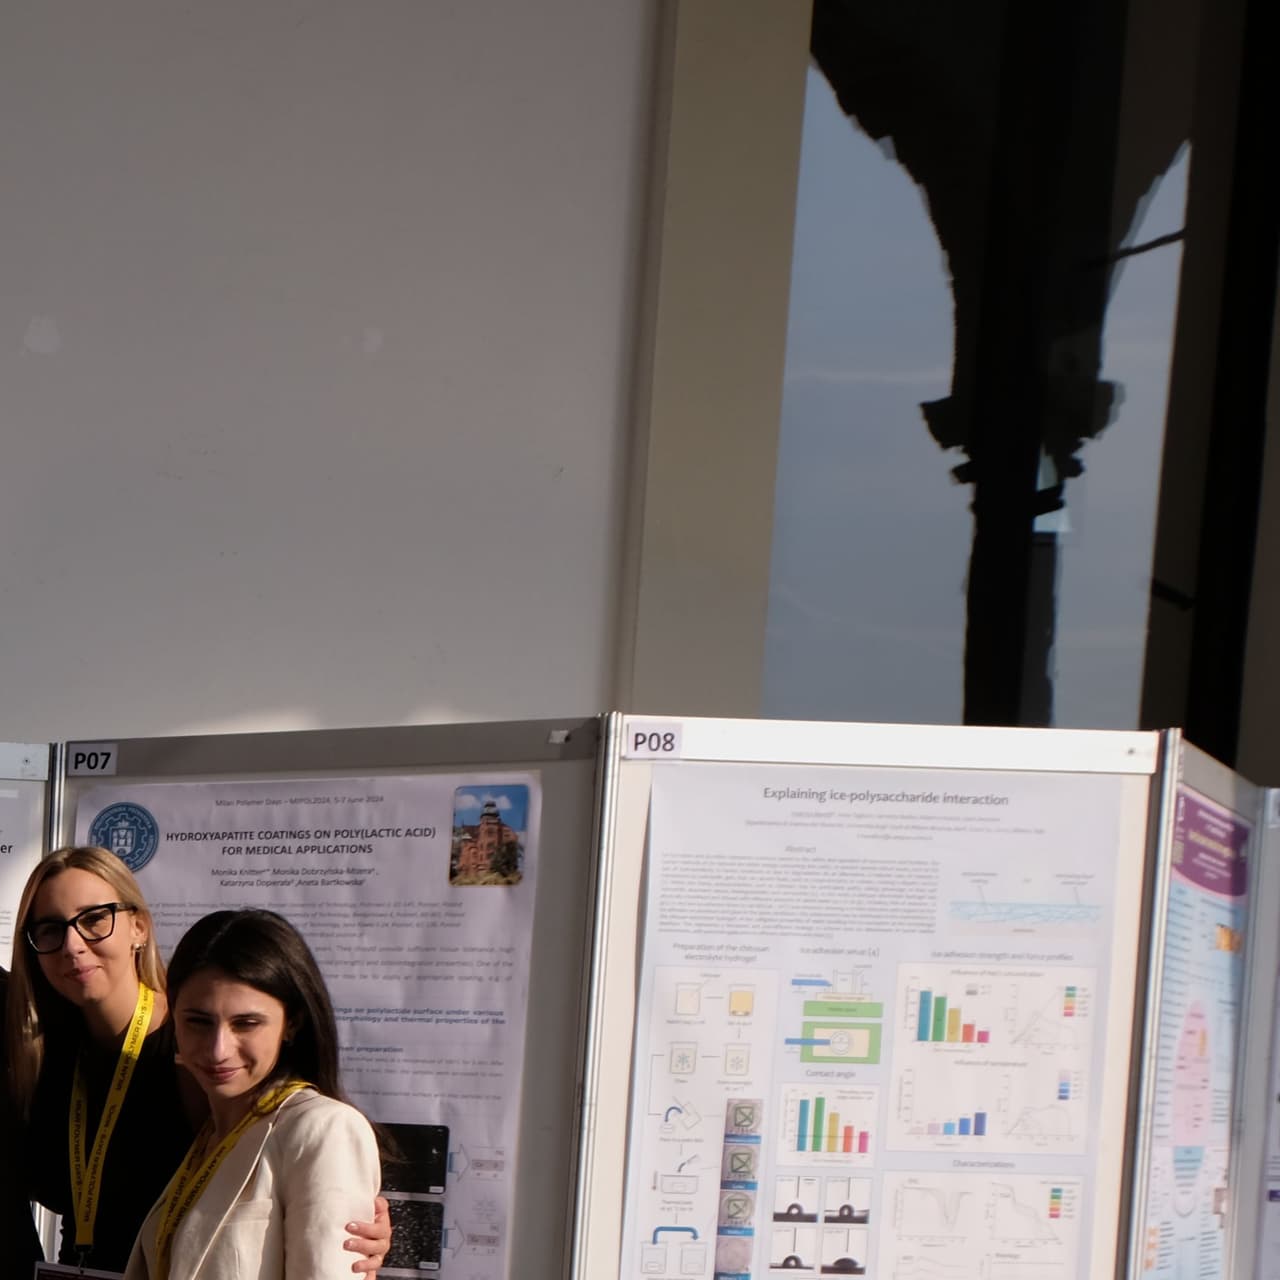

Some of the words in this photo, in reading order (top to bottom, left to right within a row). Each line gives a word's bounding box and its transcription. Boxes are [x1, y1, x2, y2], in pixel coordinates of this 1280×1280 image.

[633, 732, 675, 752] P08
[73, 752, 112, 770] P07
[763, 787, 827, 803] Explaining
[830, 789, 940, 804] ice-polysaccharide
[943, 791, 1009, 805] interaction
[166, 831, 254, 841] HYDROXYAPATITE
[257, 829, 311, 840] COATINGS
[314, 829, 330, 839] ON
[334, 828, 402, 839] POLY(LACTIC
[404, 827, 436, 838] ACID)
[222, 846, 243, 856] FOR
[245, 845, 293, 855] MEDICAL
[296, 844, 373, 855] APPLICATIONS
[785, 844, 817, 853] Abstract
